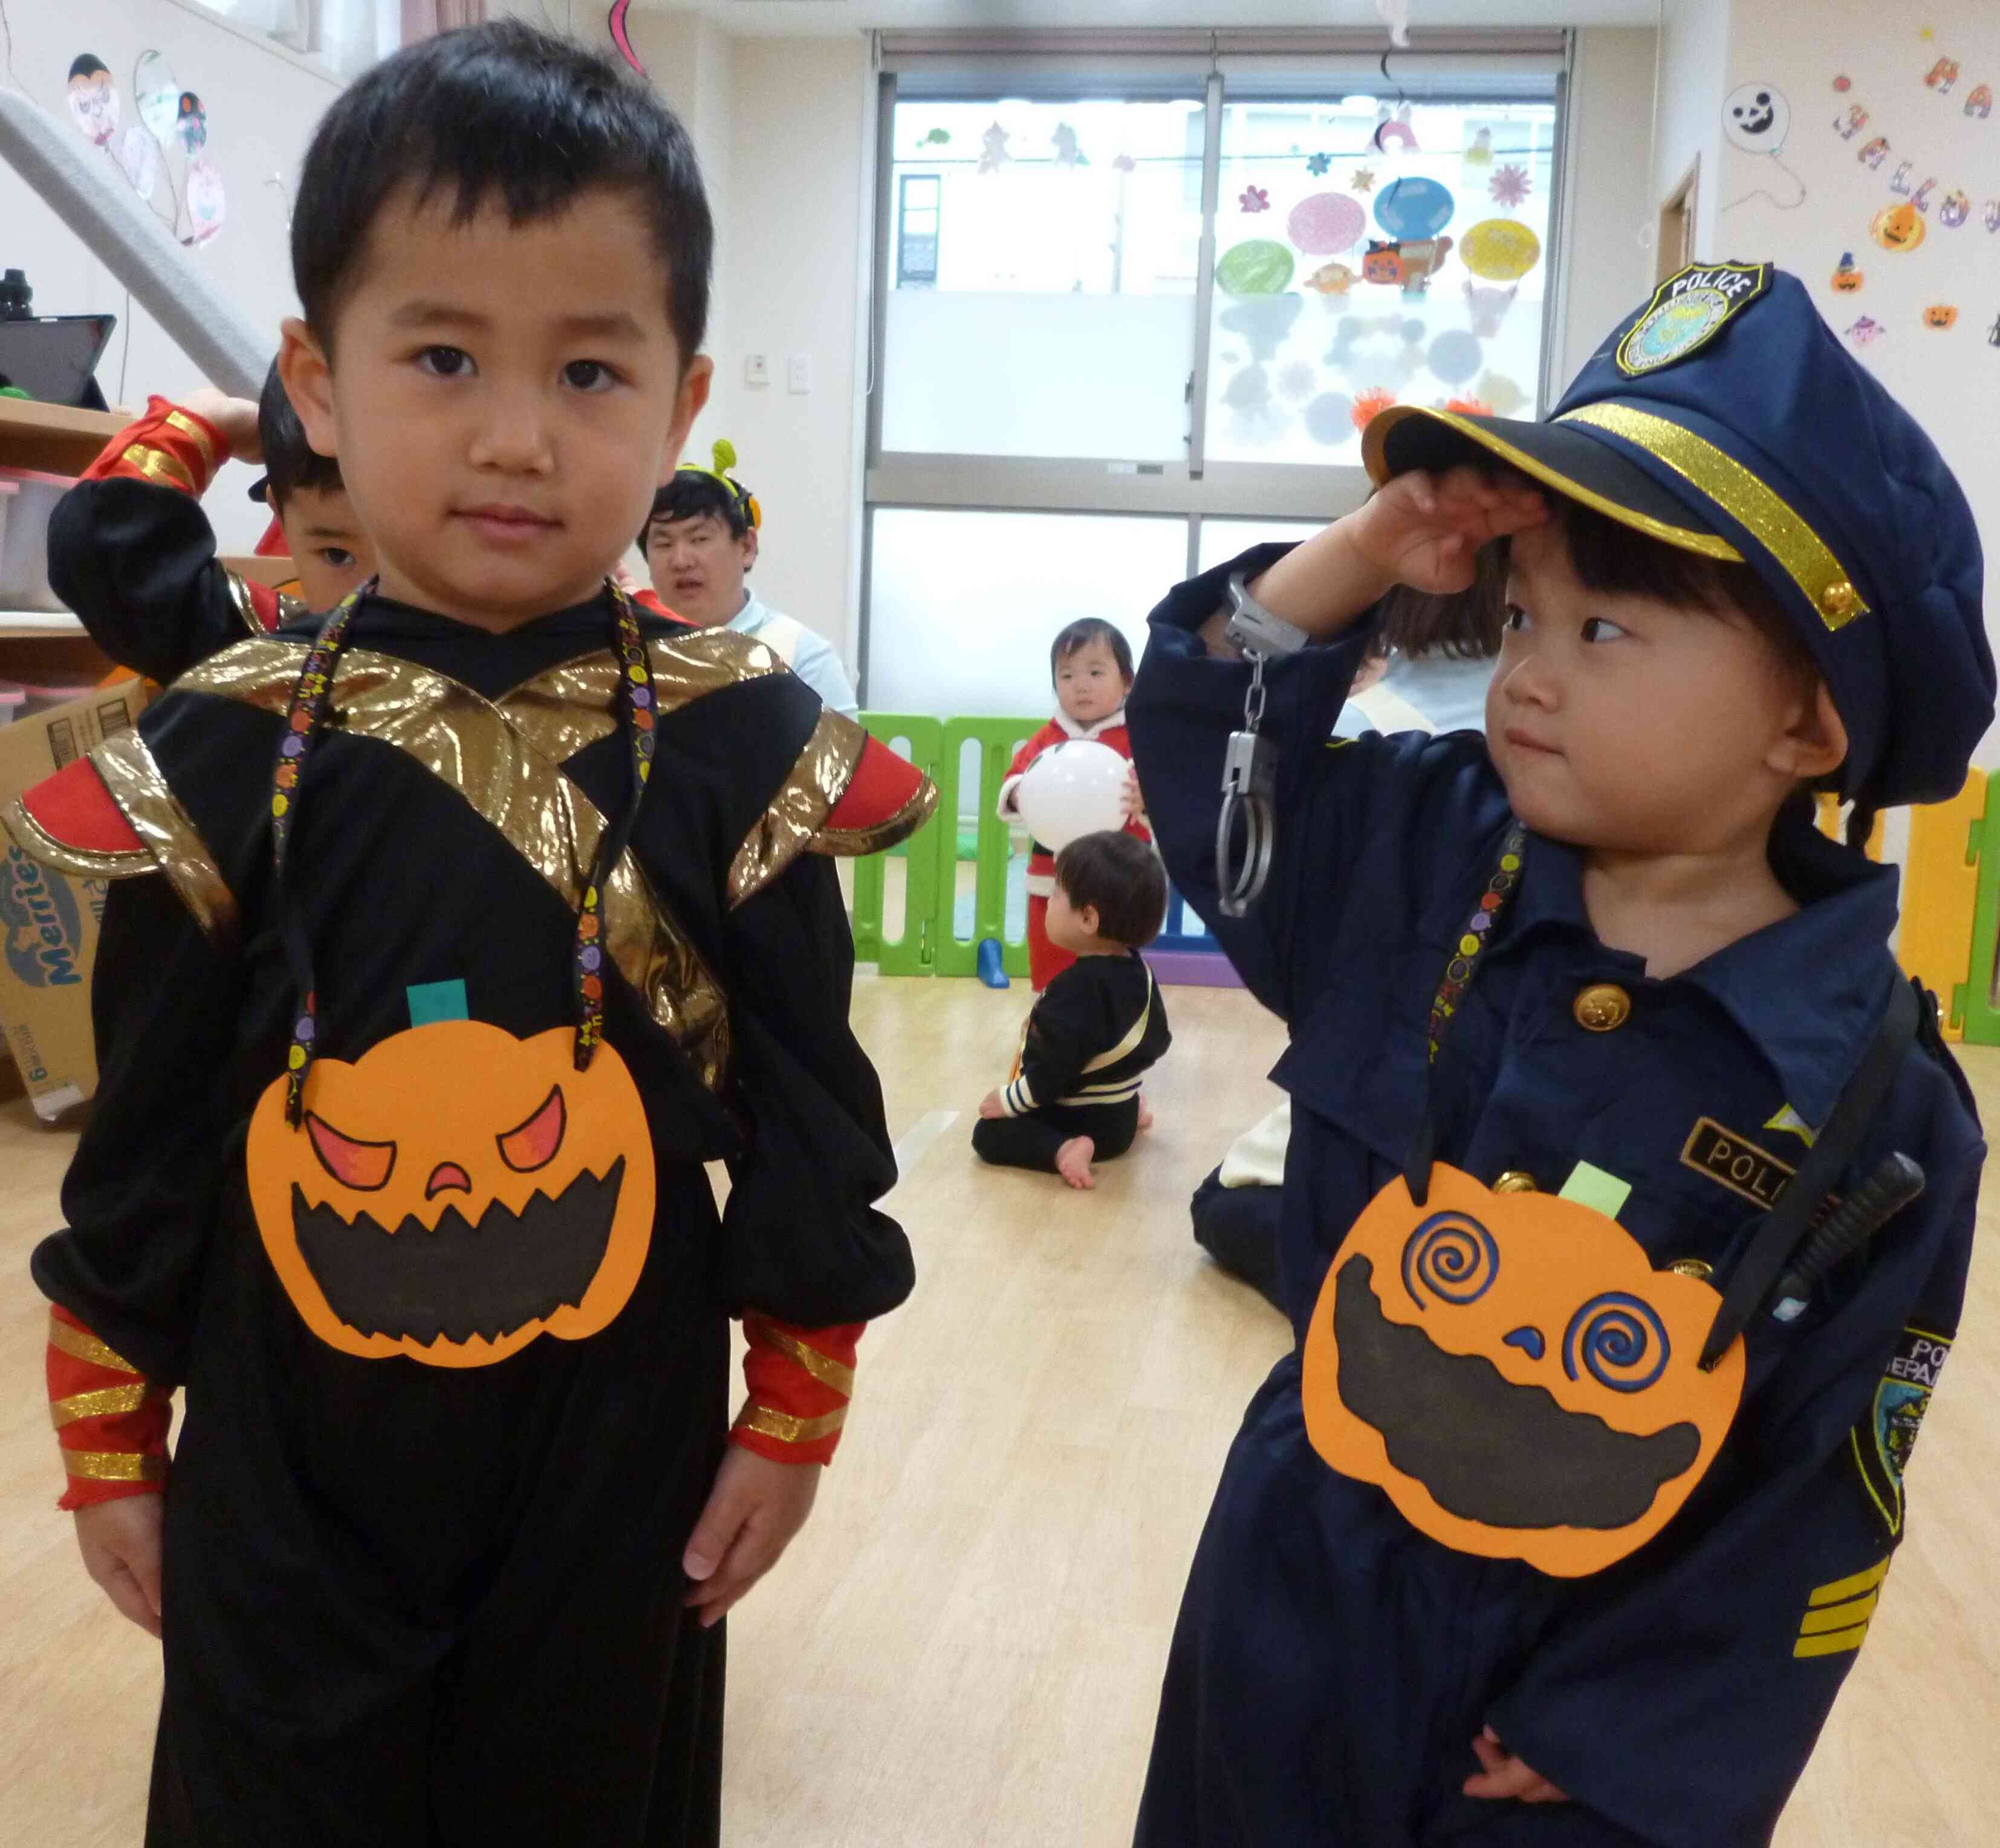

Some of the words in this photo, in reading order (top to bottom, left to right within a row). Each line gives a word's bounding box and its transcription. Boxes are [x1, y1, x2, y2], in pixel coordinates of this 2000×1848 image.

[1672, 270, 1752, 299] POLICE
[1707, 1139, 1787, 1201] POLI
[1911, 1338, 1950, 1367] PO
[1886, 1357, 1940, 1387] EPA
